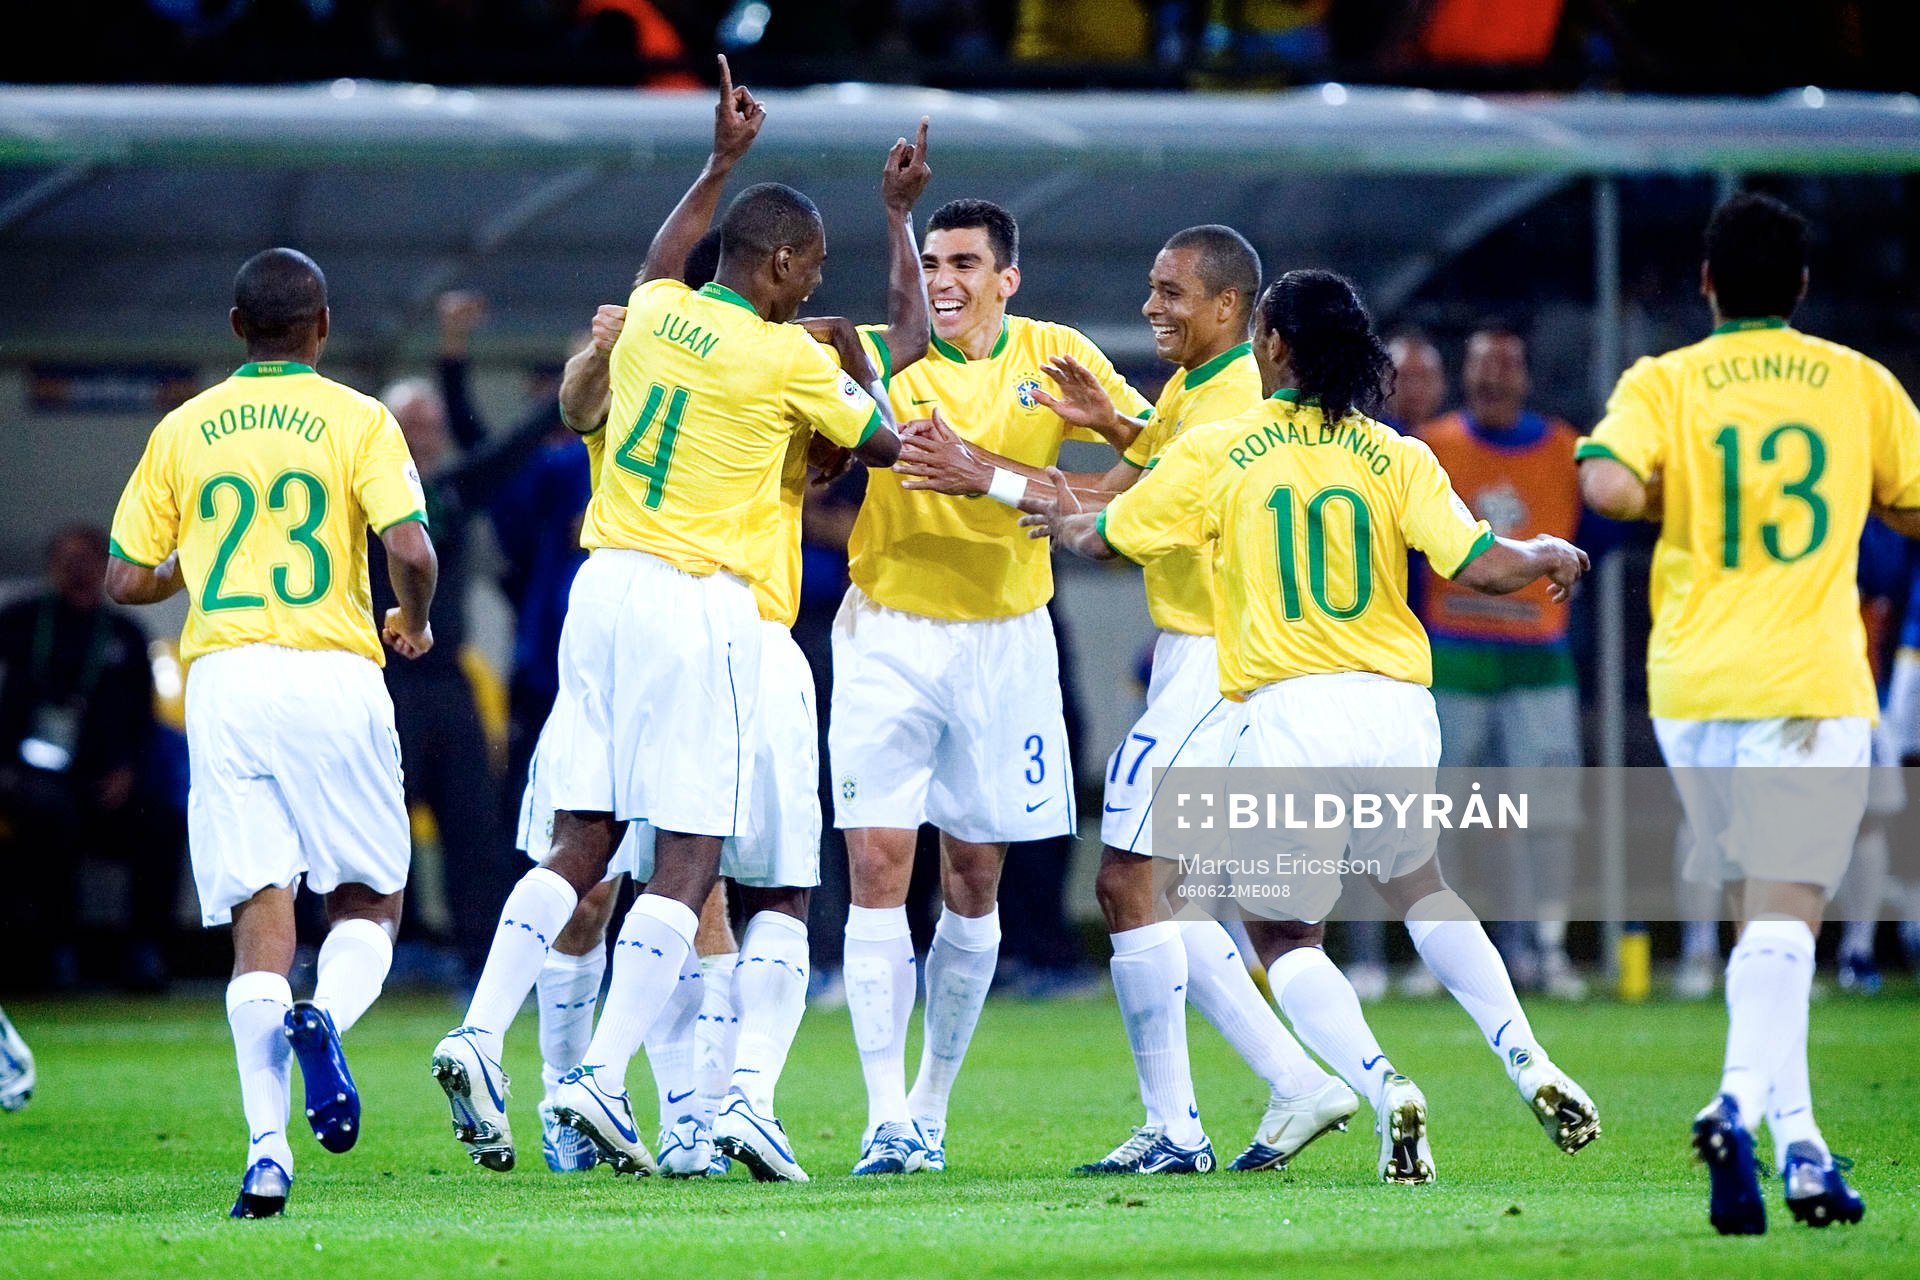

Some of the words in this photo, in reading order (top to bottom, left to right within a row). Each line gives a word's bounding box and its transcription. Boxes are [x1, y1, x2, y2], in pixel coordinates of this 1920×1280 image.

[653, 313, 720, 358] JUAN
[1703, 354, 1830, 390] CICINHO
[200, 404, 326, 445] ROBINHO
[614, 382, 691, 511] 4
[1229, 421, 1391, 476] RONALDINHO
[1715, 422, 1830, 569] 13
[198, 470, 333, 613] 23
[1264, 485, 1373, 621] 10
[1023, 734, 1046, 785] 3
[1109, 733, 1157, 785] 17
[1199, 1156, 1208, 1169] 19
